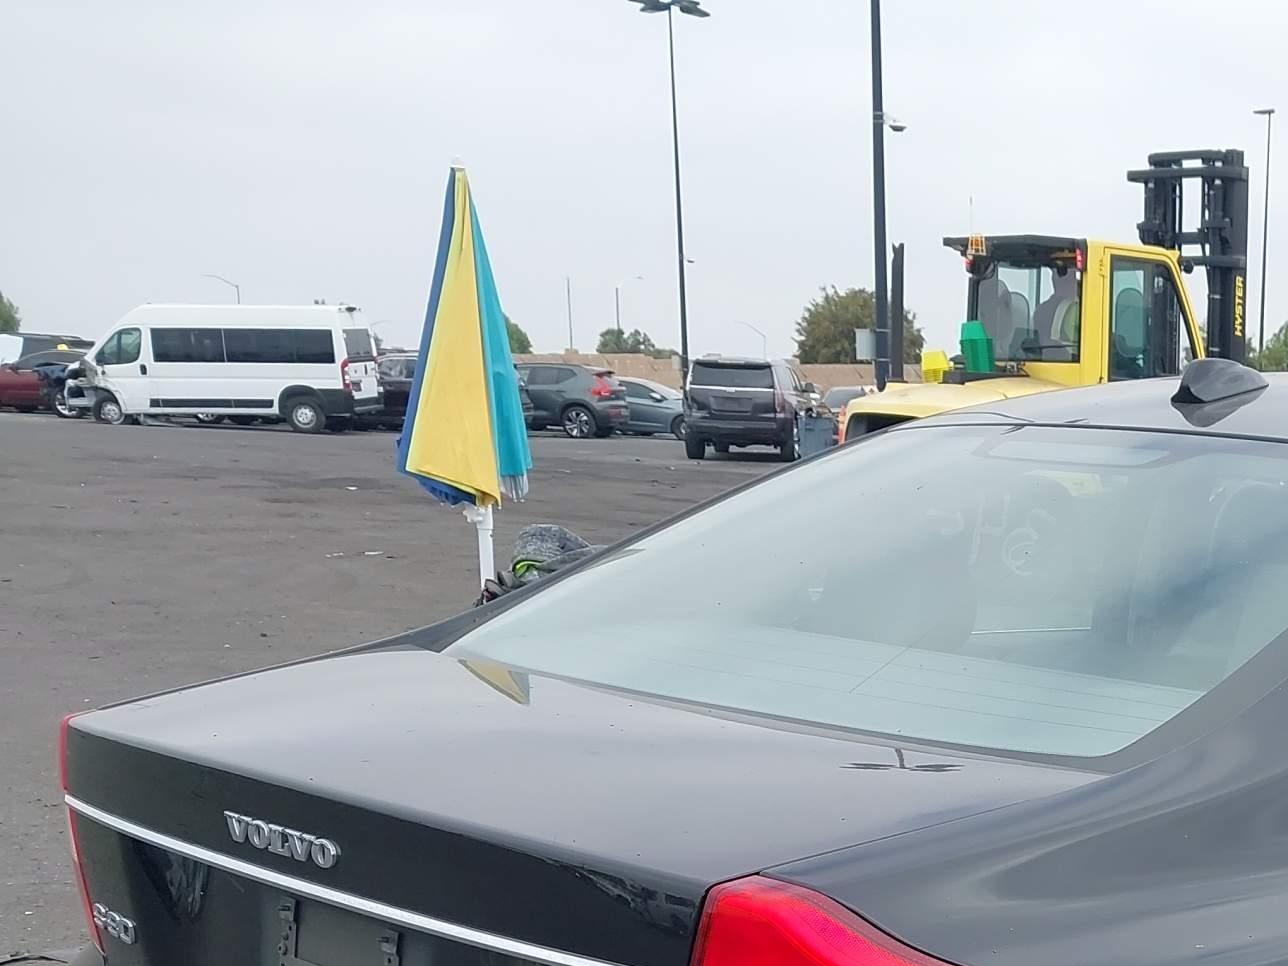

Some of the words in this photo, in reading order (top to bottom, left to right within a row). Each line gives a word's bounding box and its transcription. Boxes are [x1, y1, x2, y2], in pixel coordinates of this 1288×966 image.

[1234, 275, 1244, 337] HYSTER
[224, 810, 341, 869] VOLVO
[94, 902, 137, 945] S80
